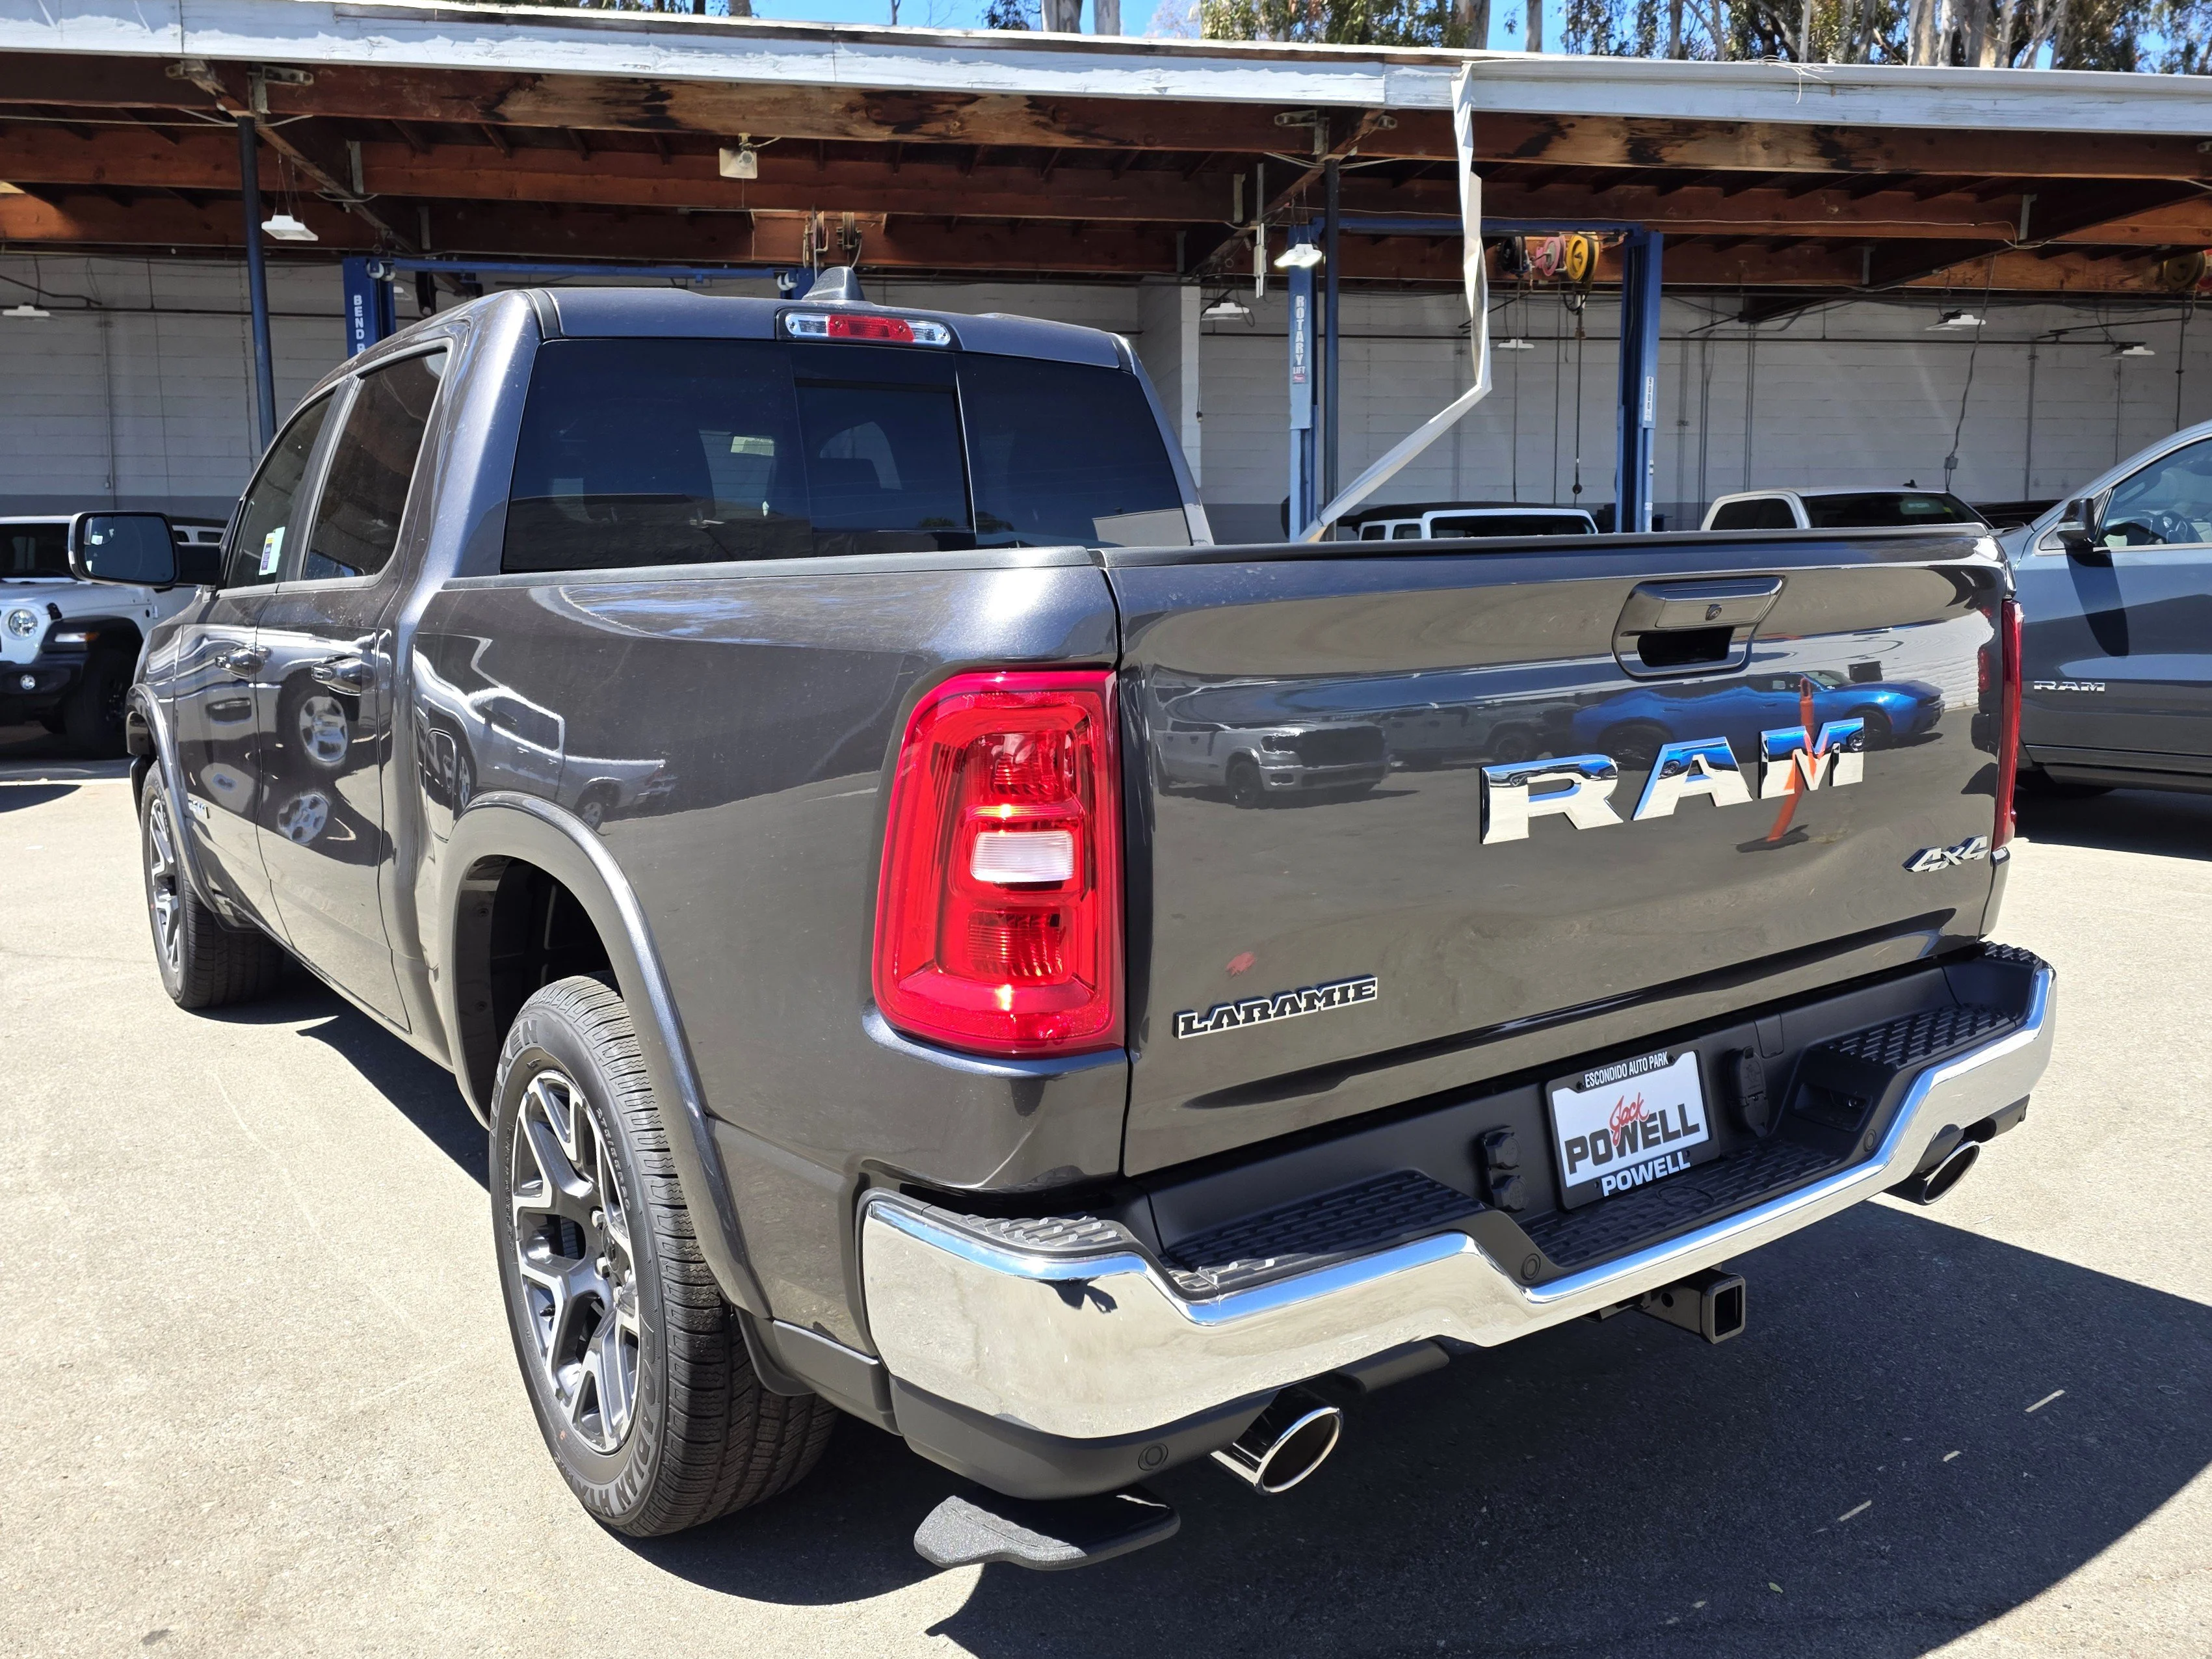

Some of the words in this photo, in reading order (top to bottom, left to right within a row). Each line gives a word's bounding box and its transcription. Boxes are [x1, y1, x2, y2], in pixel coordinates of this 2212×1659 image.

[353, 295, 365, 339] BEND
[1295, 295, 1305, 365] ROTARY
[2034, 681, 2105, 692] RAM
[1480, 717, 1864, 845] RAM
[1172, 974, 1378, 1039] LARAMIE
[1584, 1063, 1628, 1088] ESCONDIDO
[1629, 1057, 1648, 1076] AUTO
[1649, 1051, 1669, 1071] PARK
[1564, 1103, 1701, 1175] POWELL
[1609, 1092, 1650, 1147] Jack
[1601, 1151, 1691, 1198] POWELL
